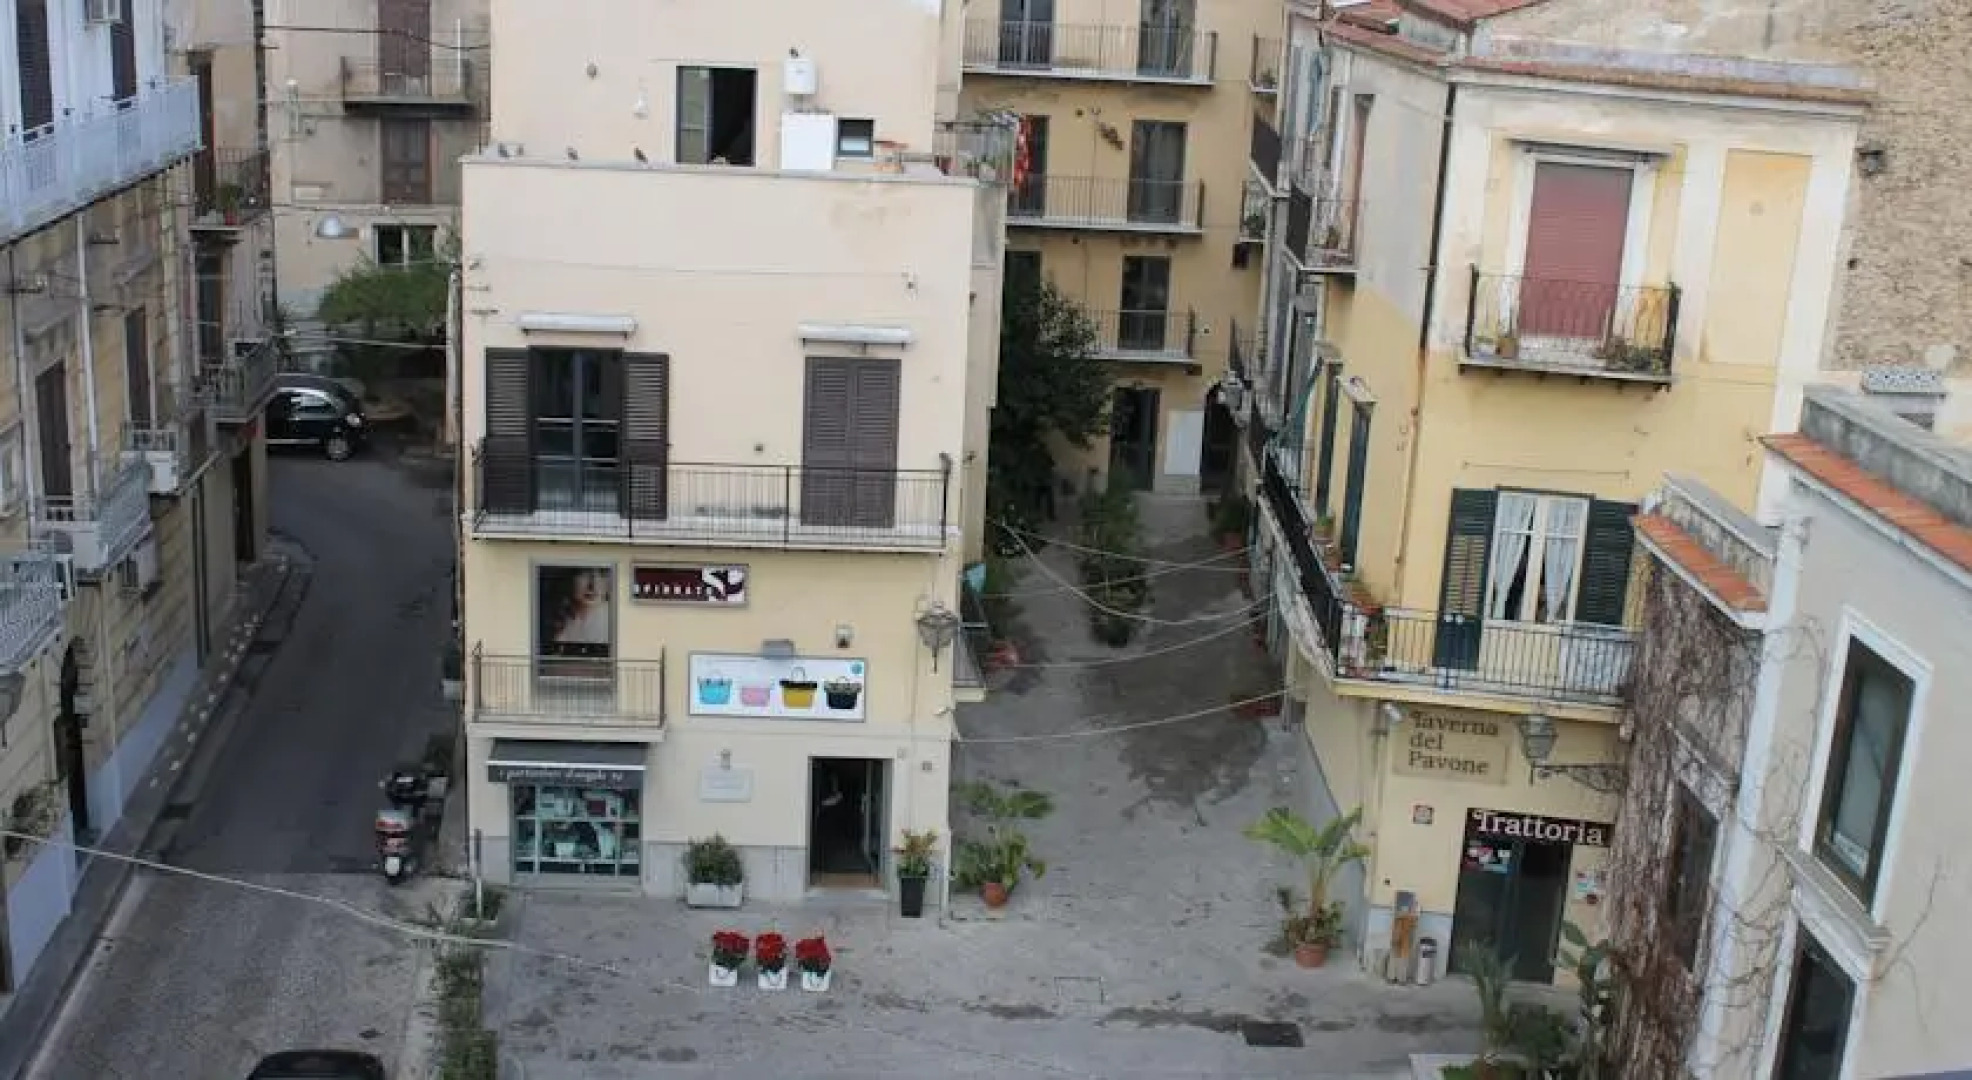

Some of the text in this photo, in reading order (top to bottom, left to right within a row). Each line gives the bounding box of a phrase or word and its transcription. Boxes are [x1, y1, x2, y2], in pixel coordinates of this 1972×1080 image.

[1409, 711, 1498, 736] Taverna
[1409, 731, 1443, 751] del
[1408, 750, 1488, 775] Pavone
[1473, 809, 1604, 845] Trattoria
